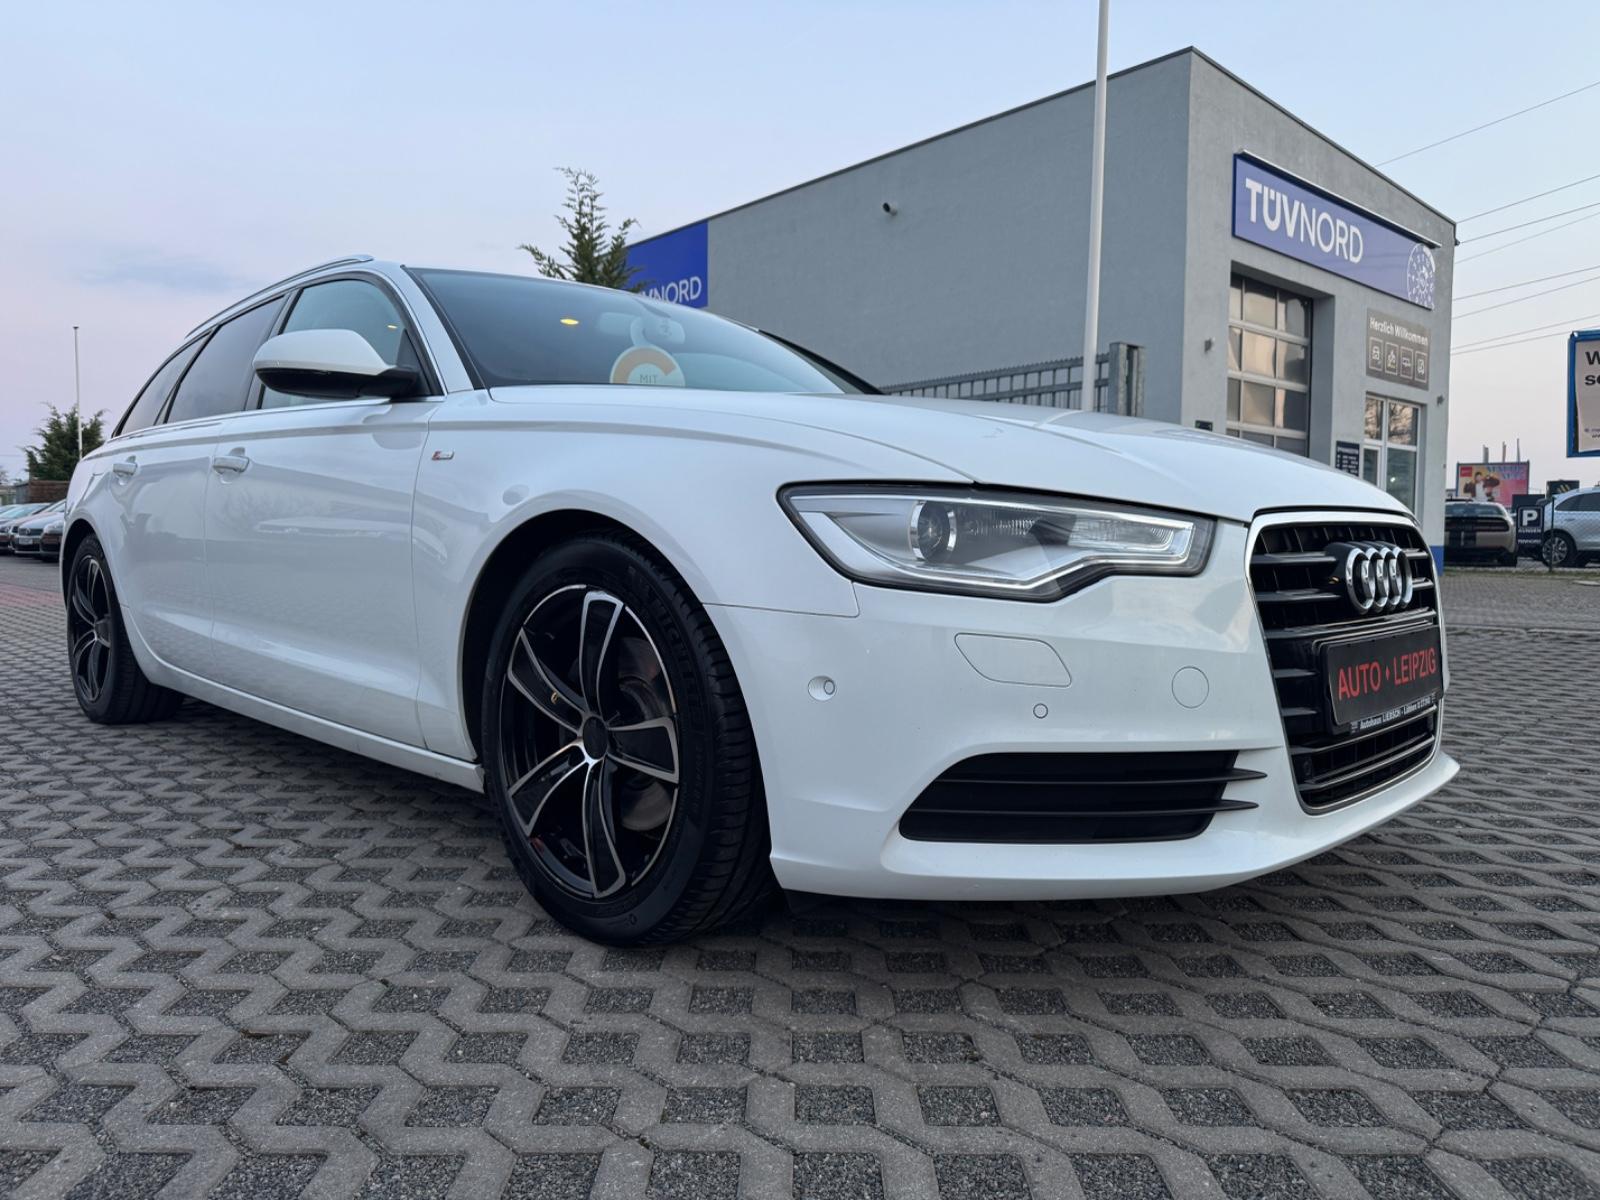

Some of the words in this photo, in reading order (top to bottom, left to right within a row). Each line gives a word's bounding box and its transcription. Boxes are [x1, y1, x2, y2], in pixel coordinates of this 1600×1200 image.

[1245, 177, 1363, 264] TÜVNORD
[1369, 316, 1395, 337] Herzlich
[1394, 323, 1429, 347] Willkommen
[1522, 509, 1538, 526] P
[1338, 661, 1381, 700] AUTO
[1393, 647, 1437, 686] LEIPZIG
